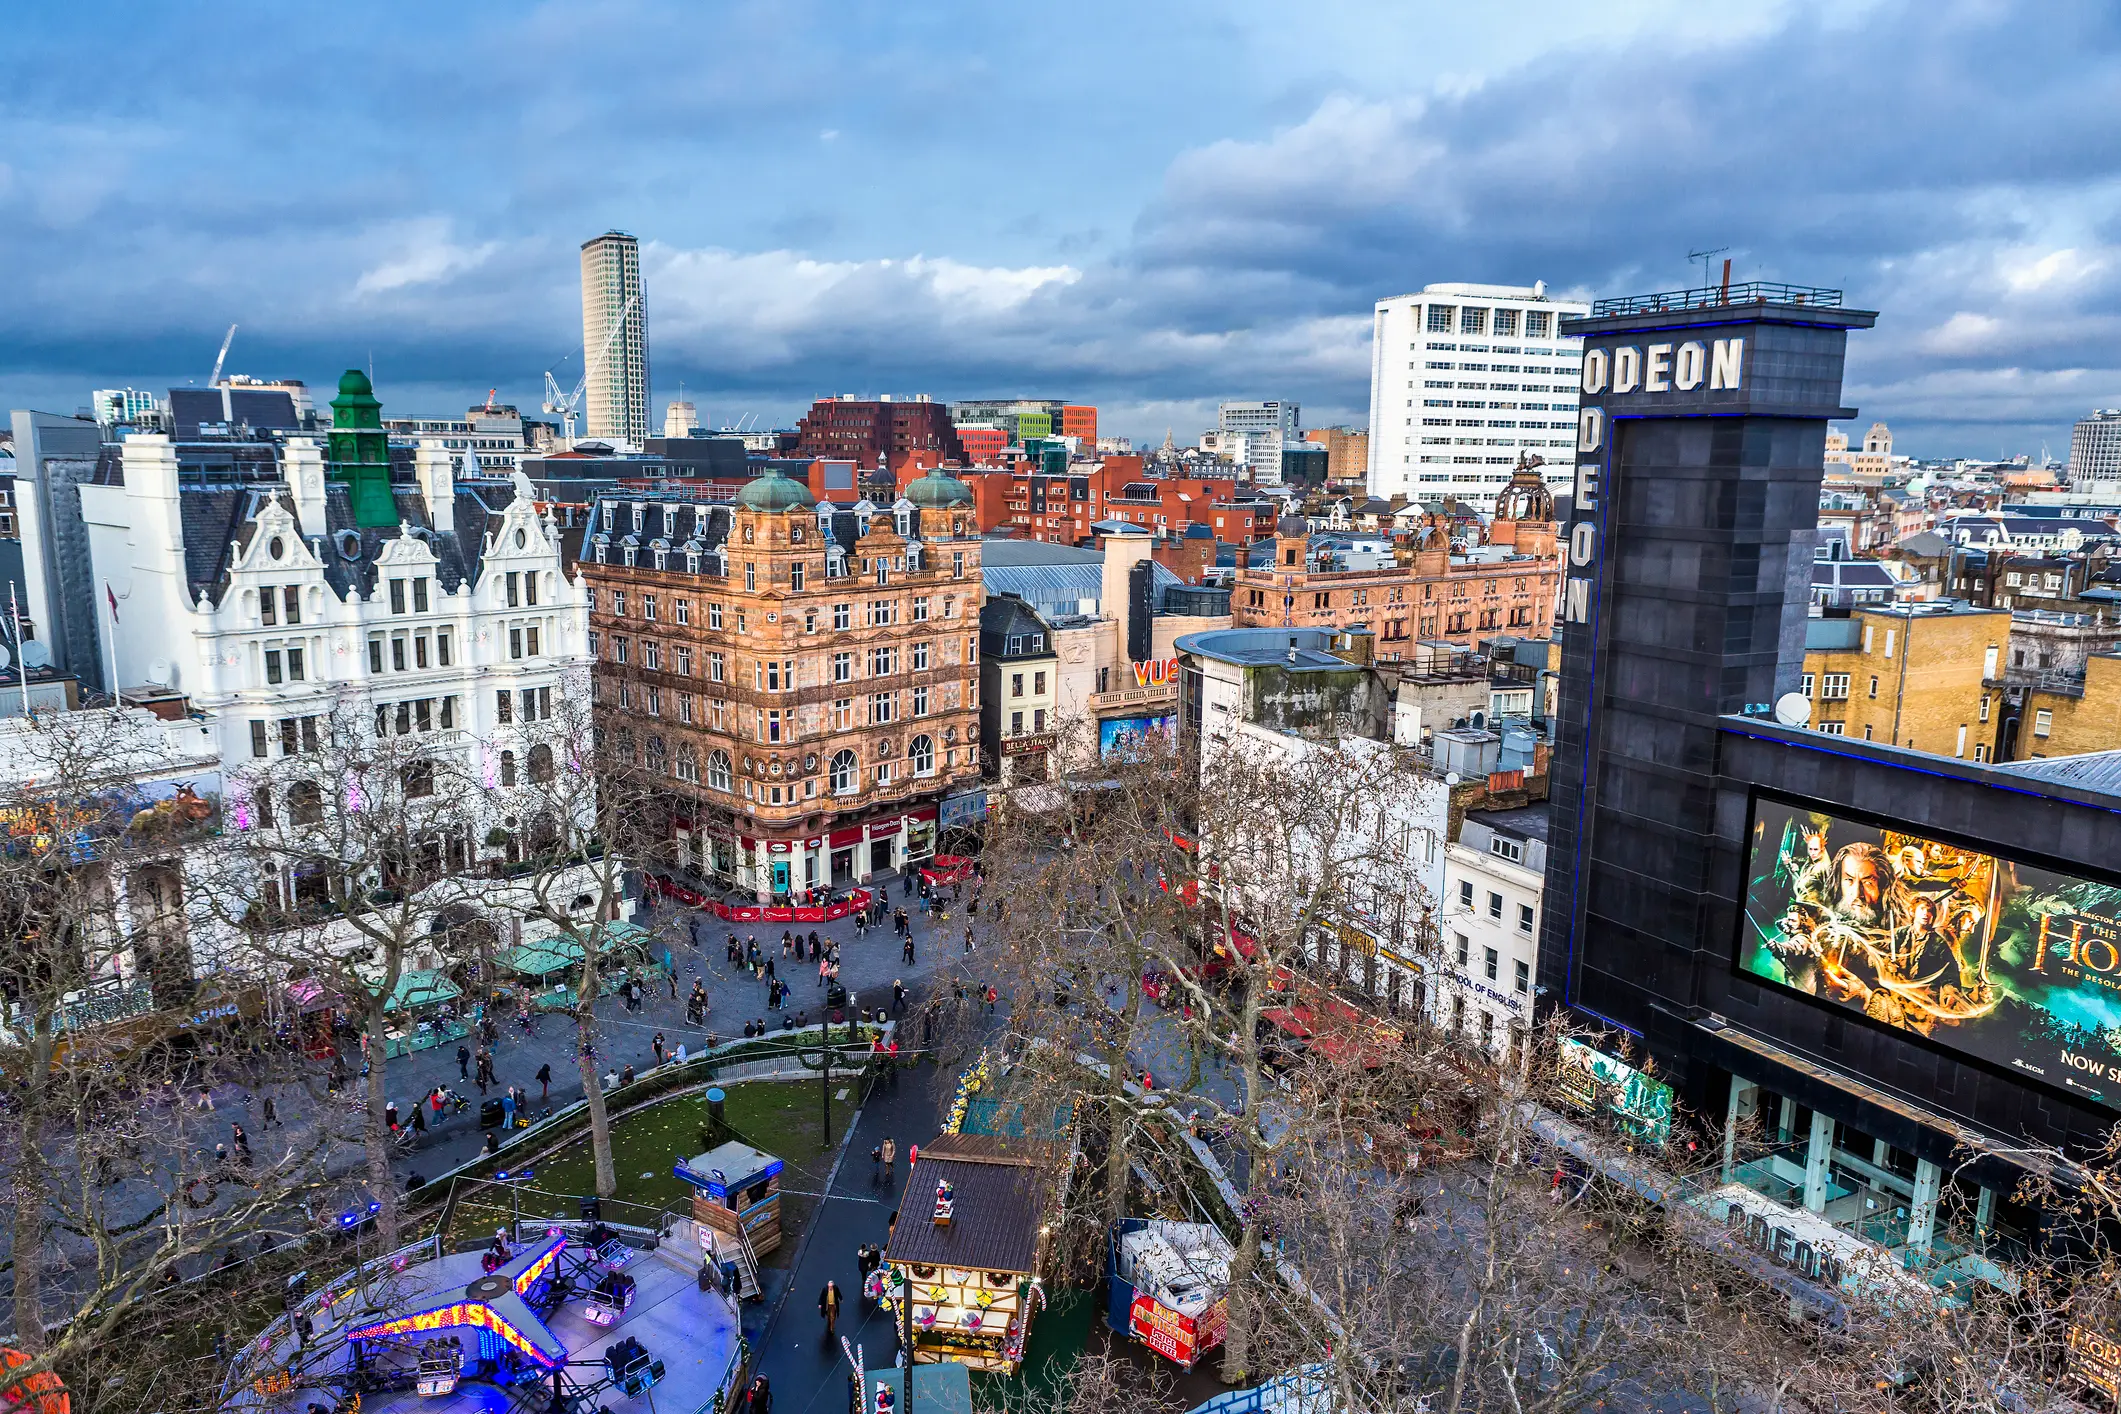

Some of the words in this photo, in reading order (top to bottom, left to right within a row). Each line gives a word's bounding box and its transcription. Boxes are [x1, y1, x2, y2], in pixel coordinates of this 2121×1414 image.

[1582, 338, 1745, 395] ODEON
[1006, 740, 1028, 750] BELLA
[2080, 911, 2114, 925] DIRECTOR
[2092, 925, 2117, 940] THE
[2028, 911, 2121, 976] HO
[2061, 966, 2079, 978] THE
[1443, 967, 1473, 989] SCHOOL
[1475, 983, 1486, 993] OF
[1487, 988, 1521, 1011] ENGLISH
[2060, 1049, 2105, 1076] NOW
